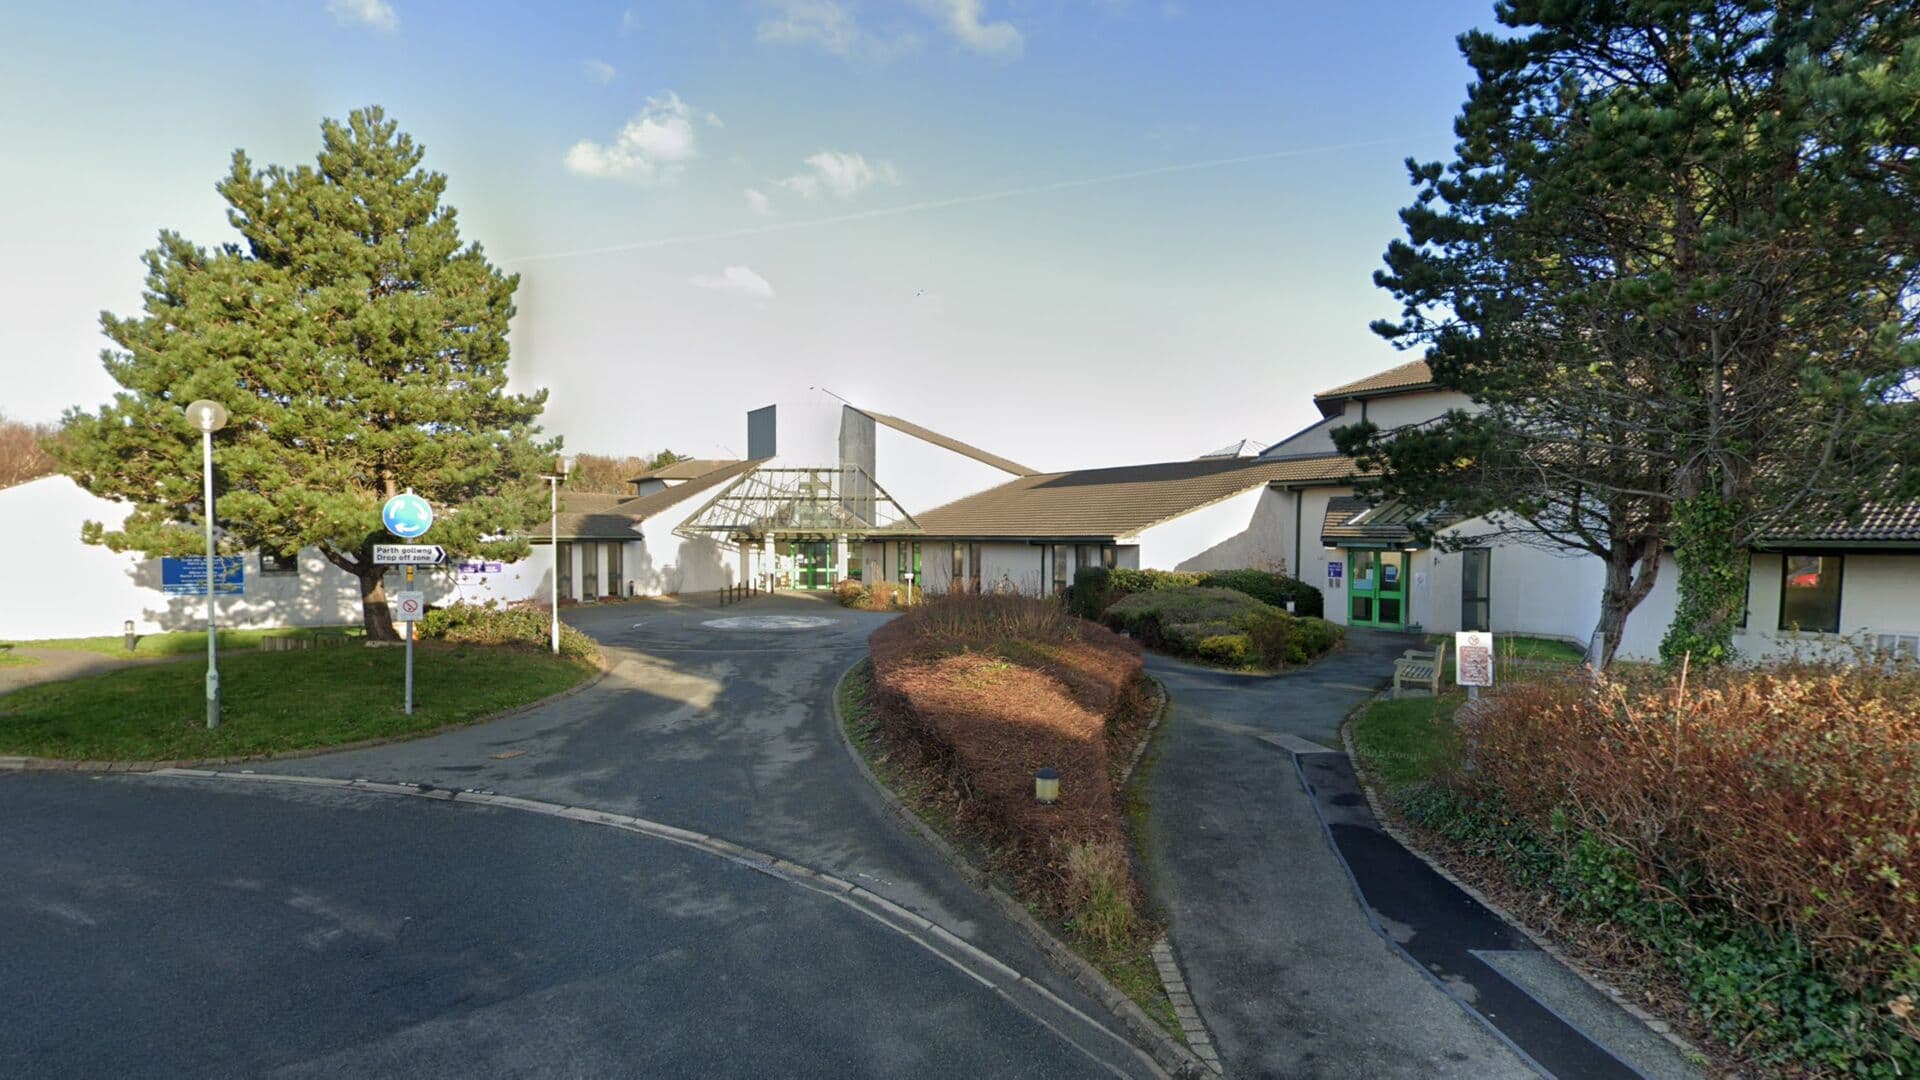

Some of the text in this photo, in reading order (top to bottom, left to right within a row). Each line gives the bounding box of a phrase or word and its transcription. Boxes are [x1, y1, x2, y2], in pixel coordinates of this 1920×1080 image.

[376, 546, 432, 555] Parth gollwng
[376, 554, 397, 562] Drop
